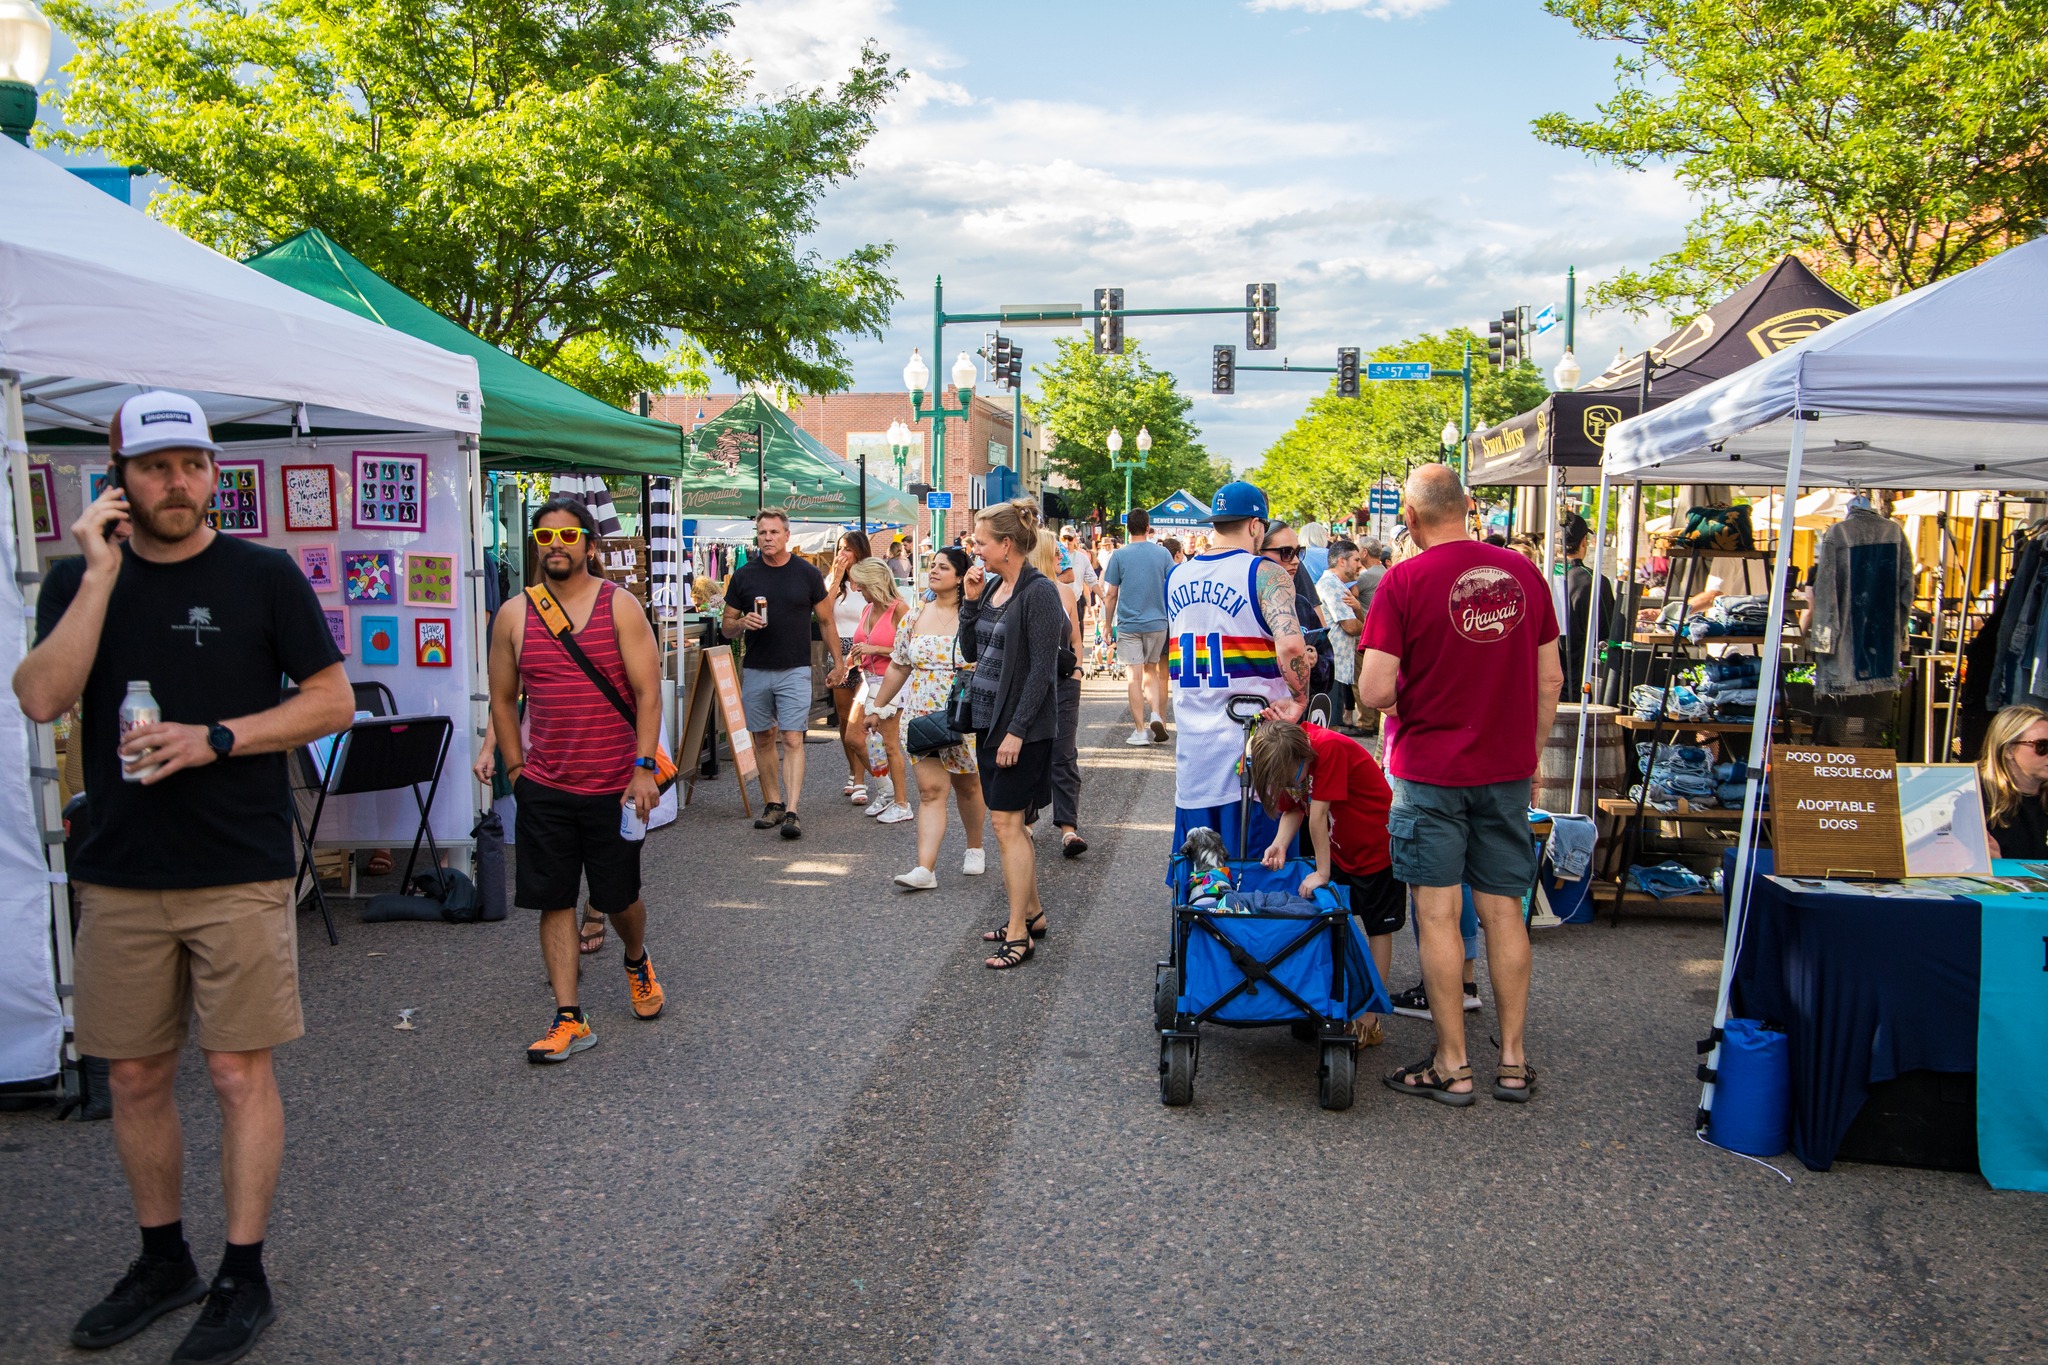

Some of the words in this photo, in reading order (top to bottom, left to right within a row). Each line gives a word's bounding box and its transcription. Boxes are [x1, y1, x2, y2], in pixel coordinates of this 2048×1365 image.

[1390, 366, 1403, 378] 57
[1480, 434, 1505, 459] SCHOOL
[1501, 427, 1526, 453] HOUSE
[289, 477, 310, 489] Give
[298, 487, 328, 500] Yourself
[682, 484, 742, 509] Marmalade
[783, 489, 847, 511] Marmalade
[294, 501, 312, 515] Time
[1168, 580, 1248, 622] ANDERSEN
[1462, 600, 1518, 634] Hawaii
[421, 623, 443, 638] Have
[1179, 632, 1230, 689] 11
[1786, 751, 1821, 763] POSO
[1827, 753, 1856, 764] DOG
[1814, 766, 1893, 780] RESCUE.COM
[1797, 799, 1876, 813] ADOPTABLE
[1819, 818, 1858, 830] DOGS
